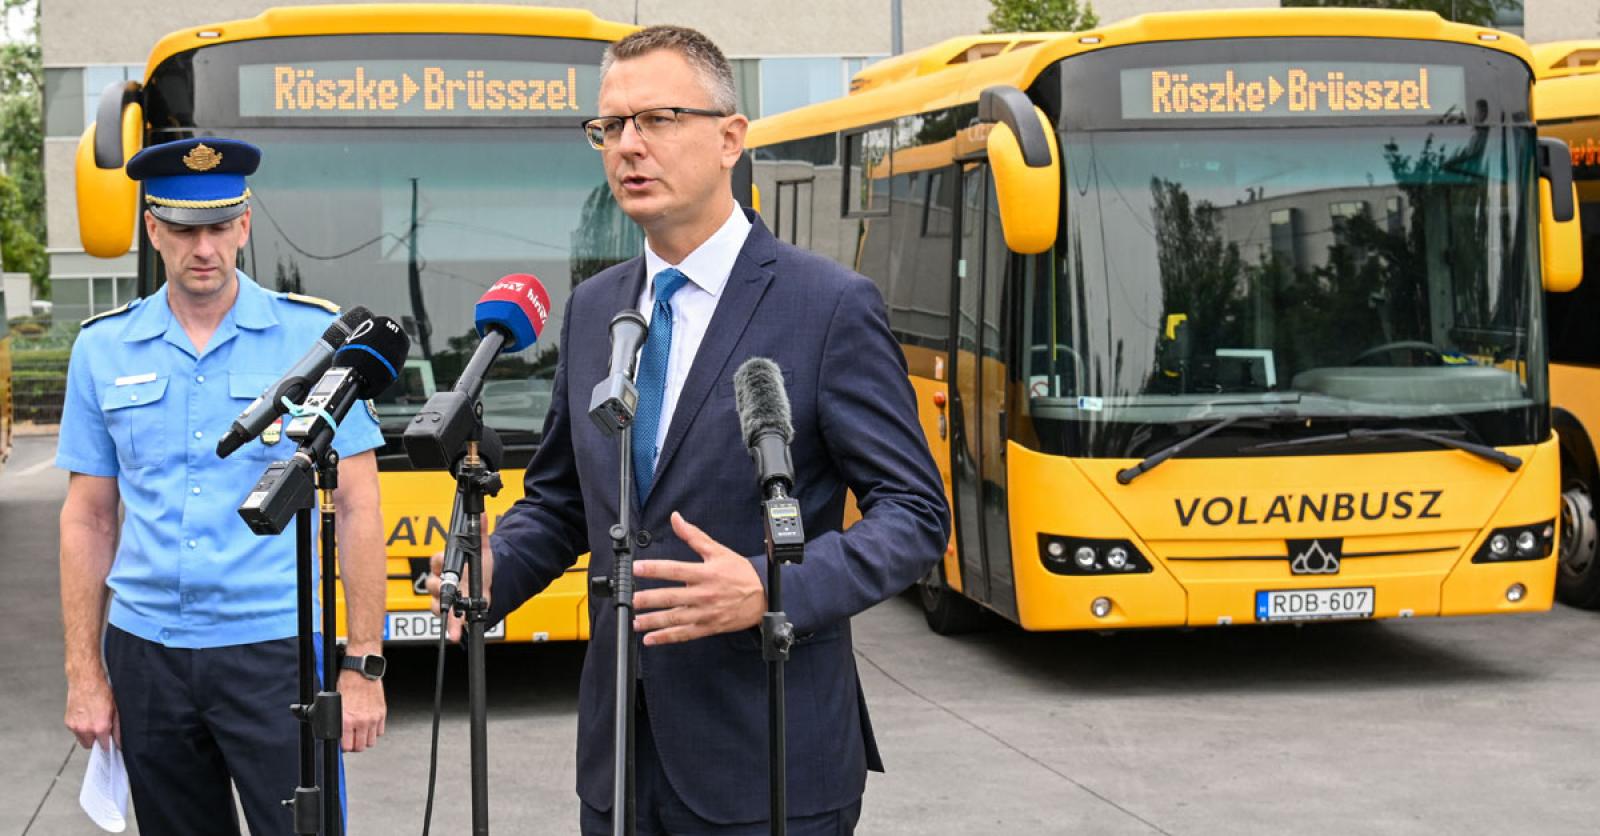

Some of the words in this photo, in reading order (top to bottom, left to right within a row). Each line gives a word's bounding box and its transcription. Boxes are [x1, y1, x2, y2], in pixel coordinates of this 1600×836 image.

[274, 66, 399, 110] Röszke
[423, 67, 580, 111] Brüsszel
[1151, 70, 1266, 113] Röszke
[1287, 68, 1432, 112] Brüsszel
[1174, 490, 1444, 527] VOLÁNBUSZ
[1273, 592, 1368, 613] RDB-607
